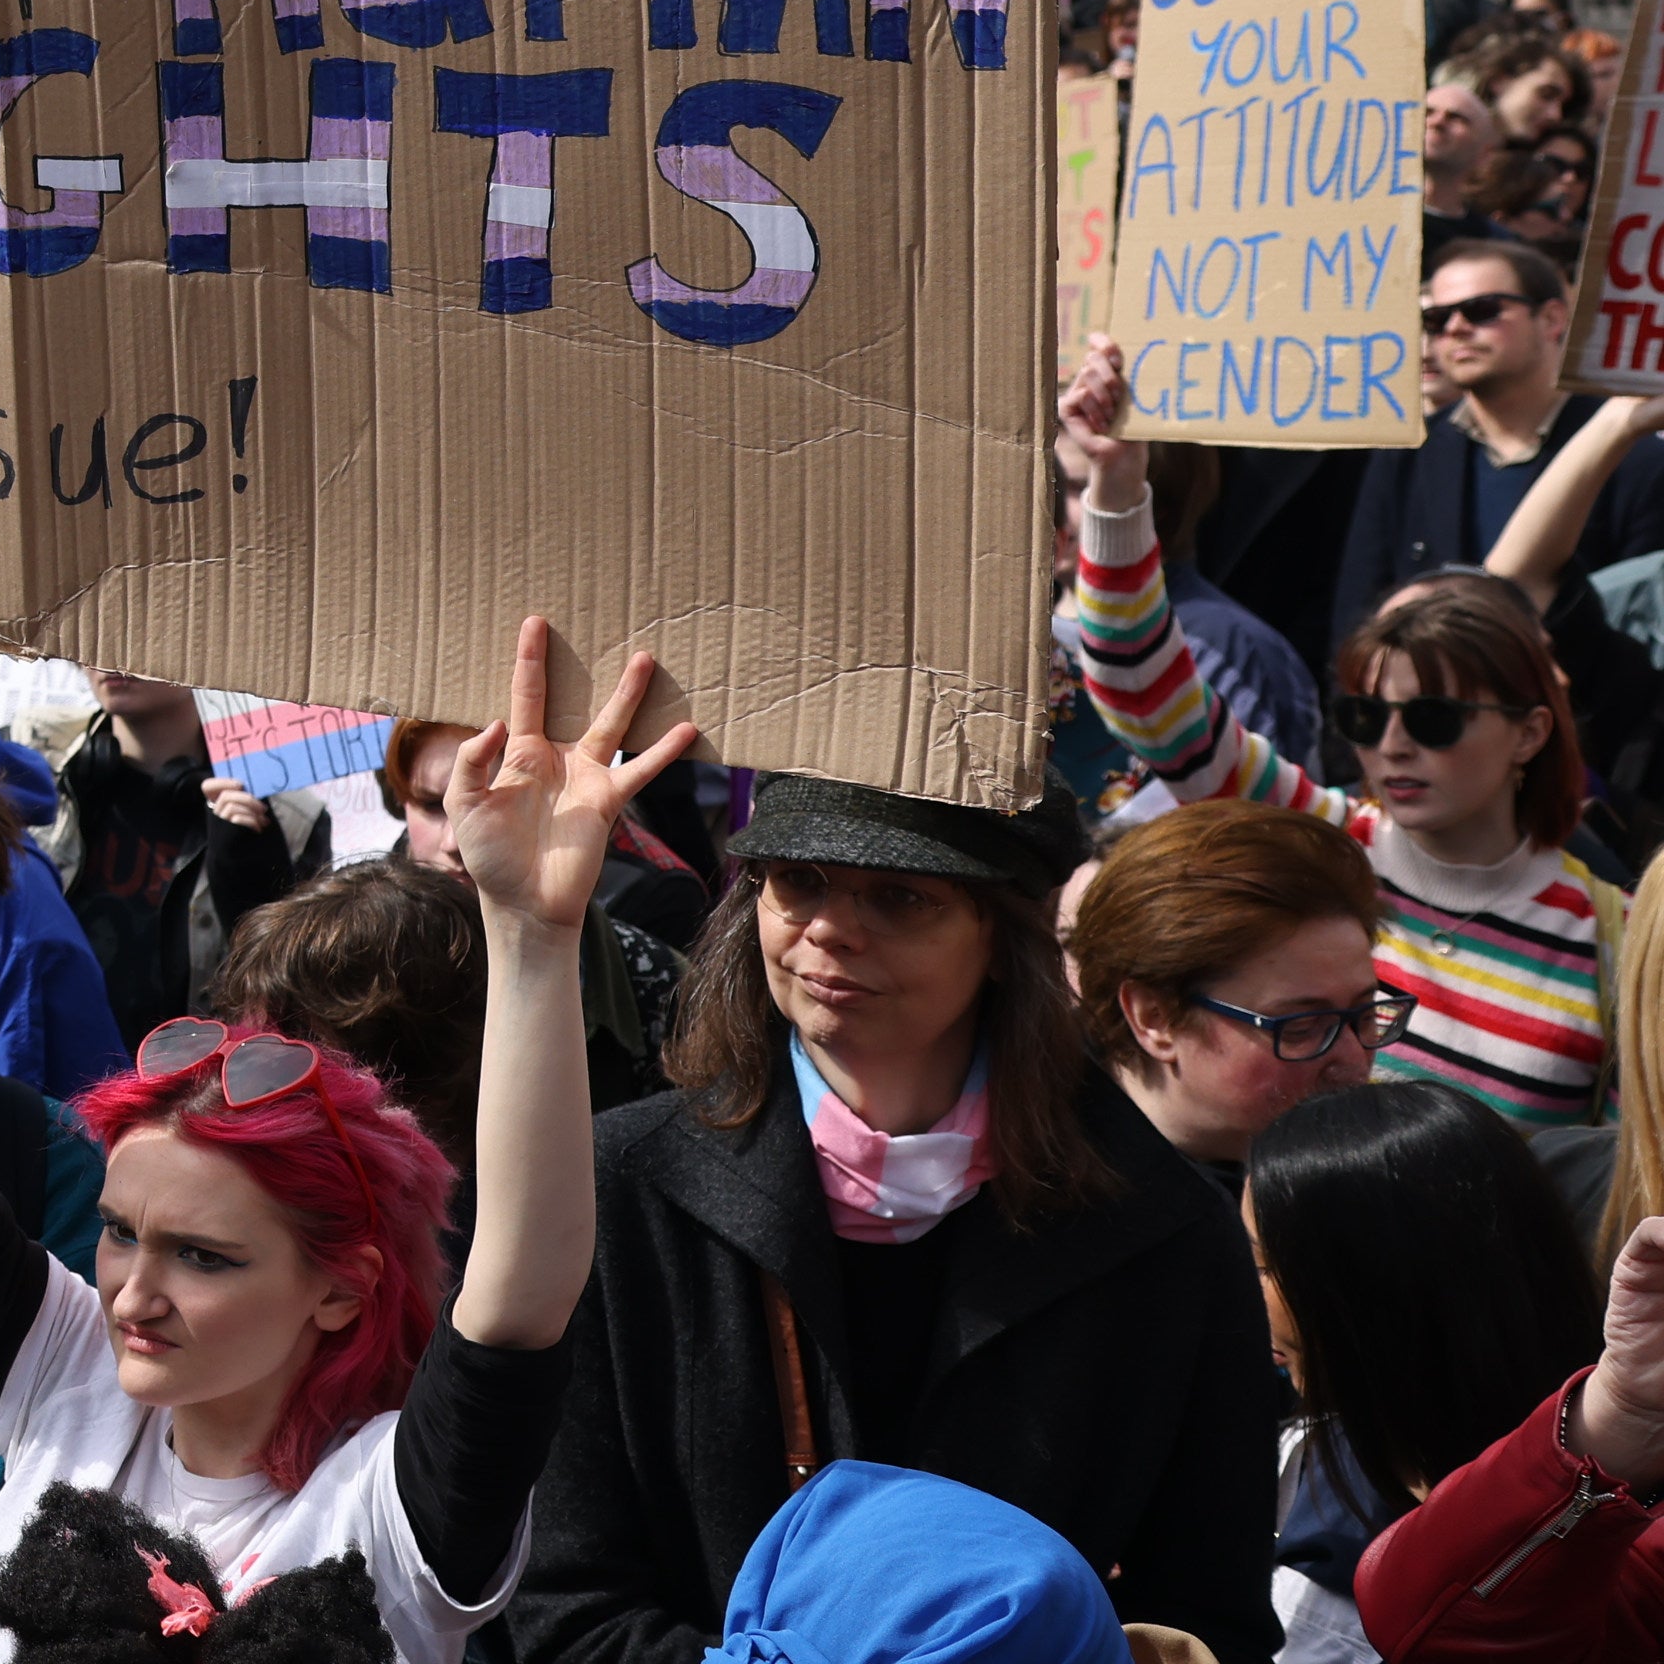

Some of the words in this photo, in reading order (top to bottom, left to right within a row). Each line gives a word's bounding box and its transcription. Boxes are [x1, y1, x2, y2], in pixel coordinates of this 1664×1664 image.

[1189, 0, 1367, 97] YOUR
[1129, 85, 1421, 219] ATTITUDE
[1145, 230, 1282, 323] NOT
[1303, 224, 1398, 312] MY
[1129, 329, 1407, 428] GENDER
